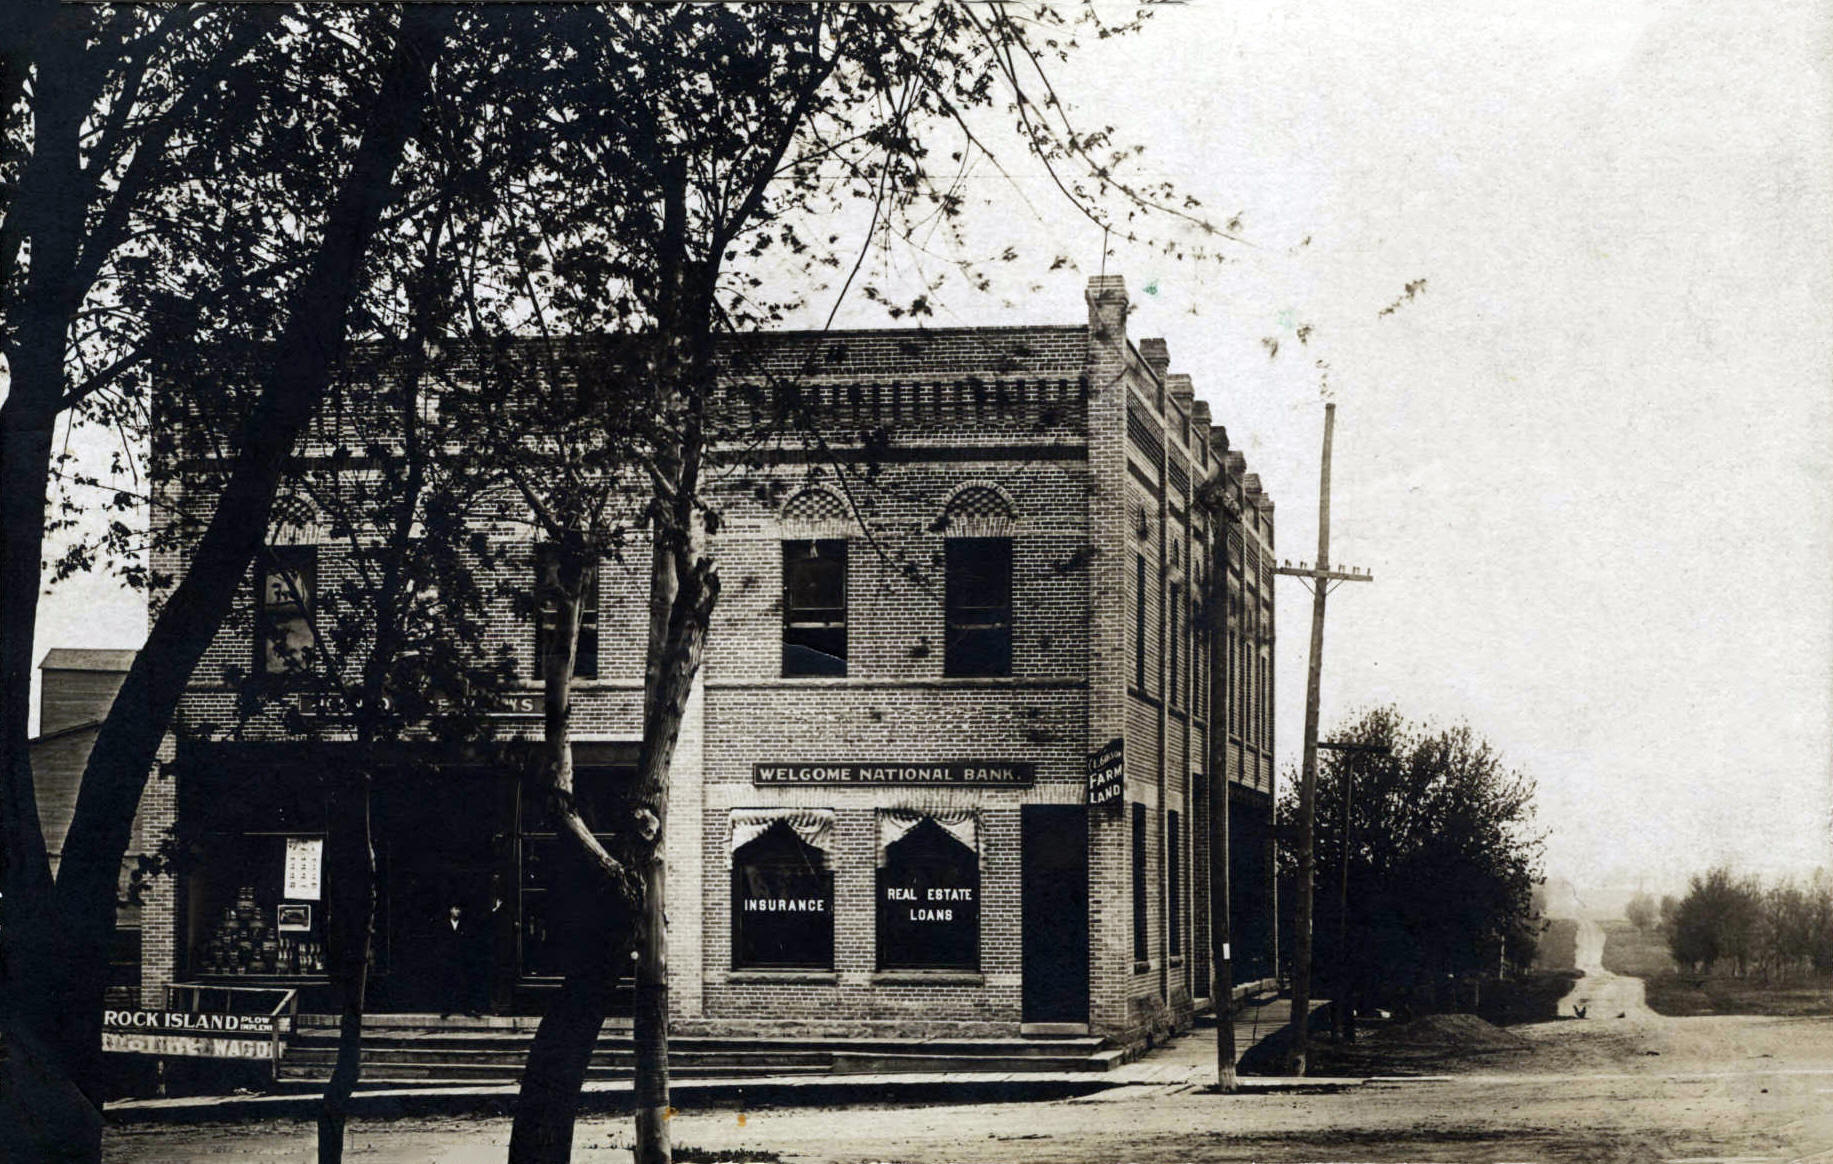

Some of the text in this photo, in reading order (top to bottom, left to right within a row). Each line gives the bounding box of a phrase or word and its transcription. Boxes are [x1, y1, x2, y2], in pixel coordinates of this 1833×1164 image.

[759, 767, 852, 781] WELCOME
[859, 767, 954, 781] NATIONAL
[1089, 764, 1123, 789] FARM
[1089, 784, 1121, 804] LAND
[887, 888, 973, 901] REAL ESTATE
[744, 899, 825, 912] INSURANCE
[909, 908, 953, 921] LOANS
[103, 1010, 239, 1031] ROCK ISLAND
[240, 1015, 271, 1025] PLOW
